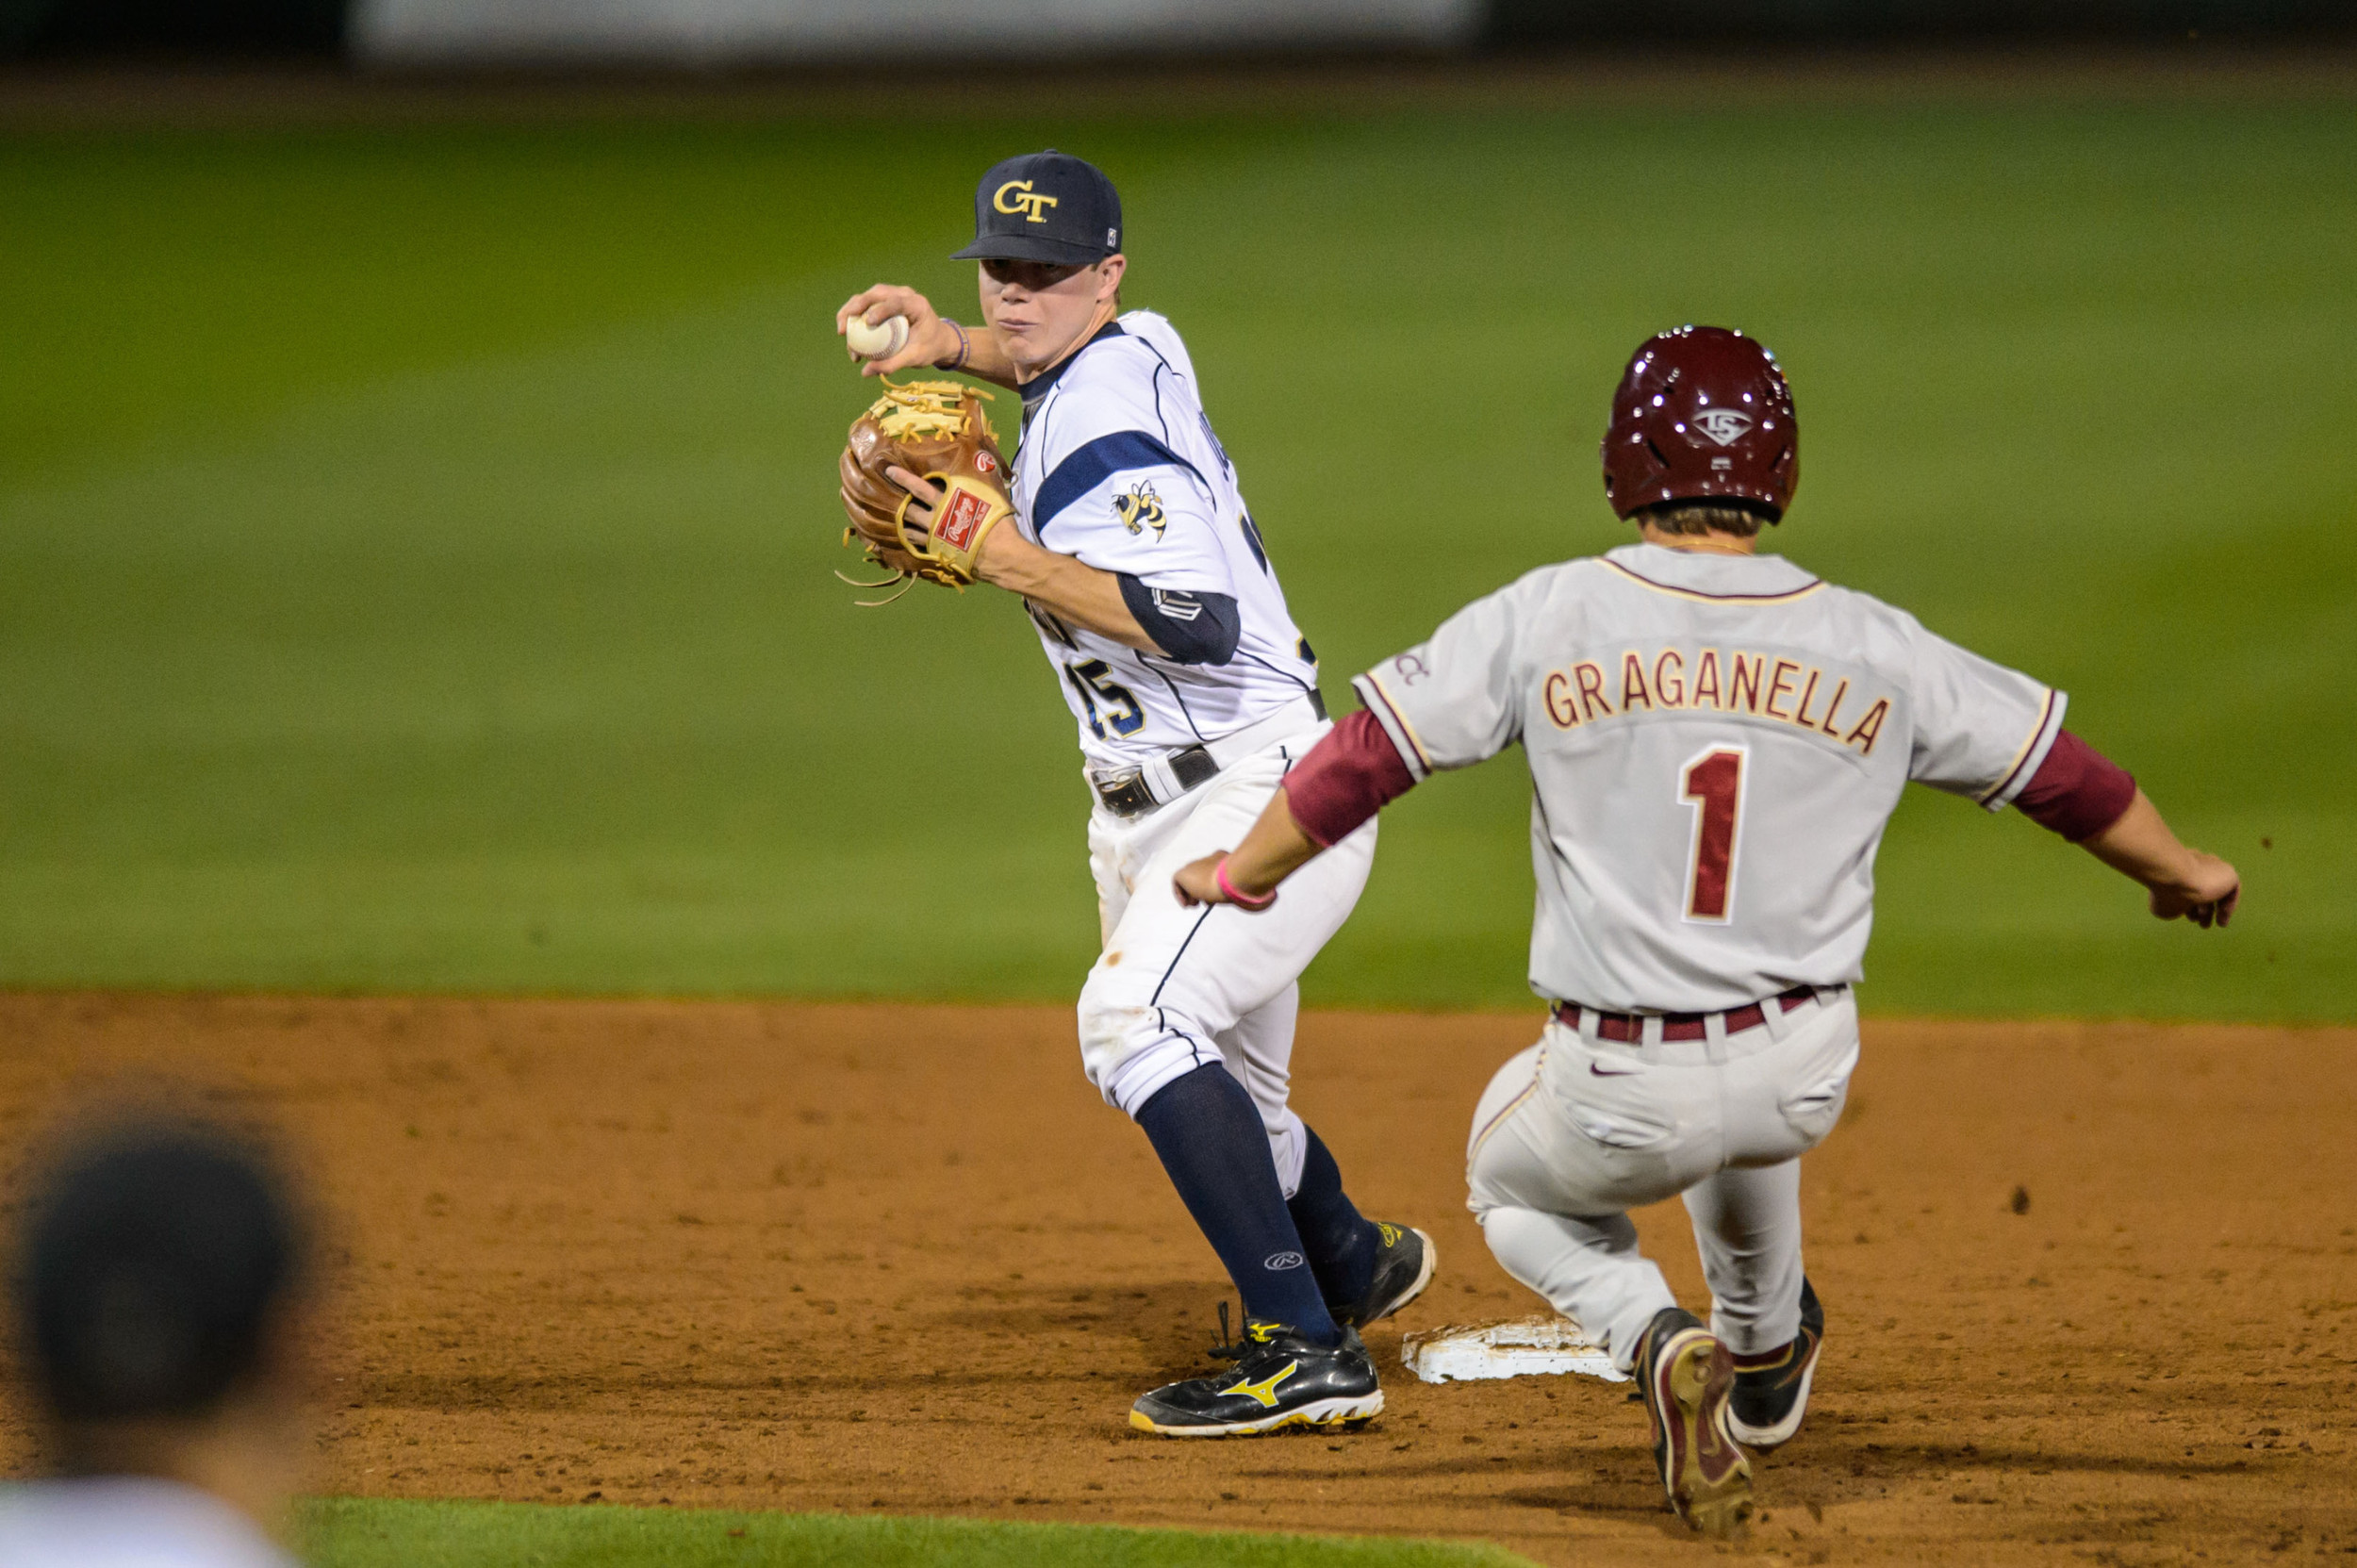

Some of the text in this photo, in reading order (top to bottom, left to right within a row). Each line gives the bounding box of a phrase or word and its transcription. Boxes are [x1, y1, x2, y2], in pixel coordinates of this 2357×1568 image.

[1063, 658, 1146, 741] 15
[1542, 647, 1892, 756] GRAGANELLA
[1677, 742, 1749, 925] 1
